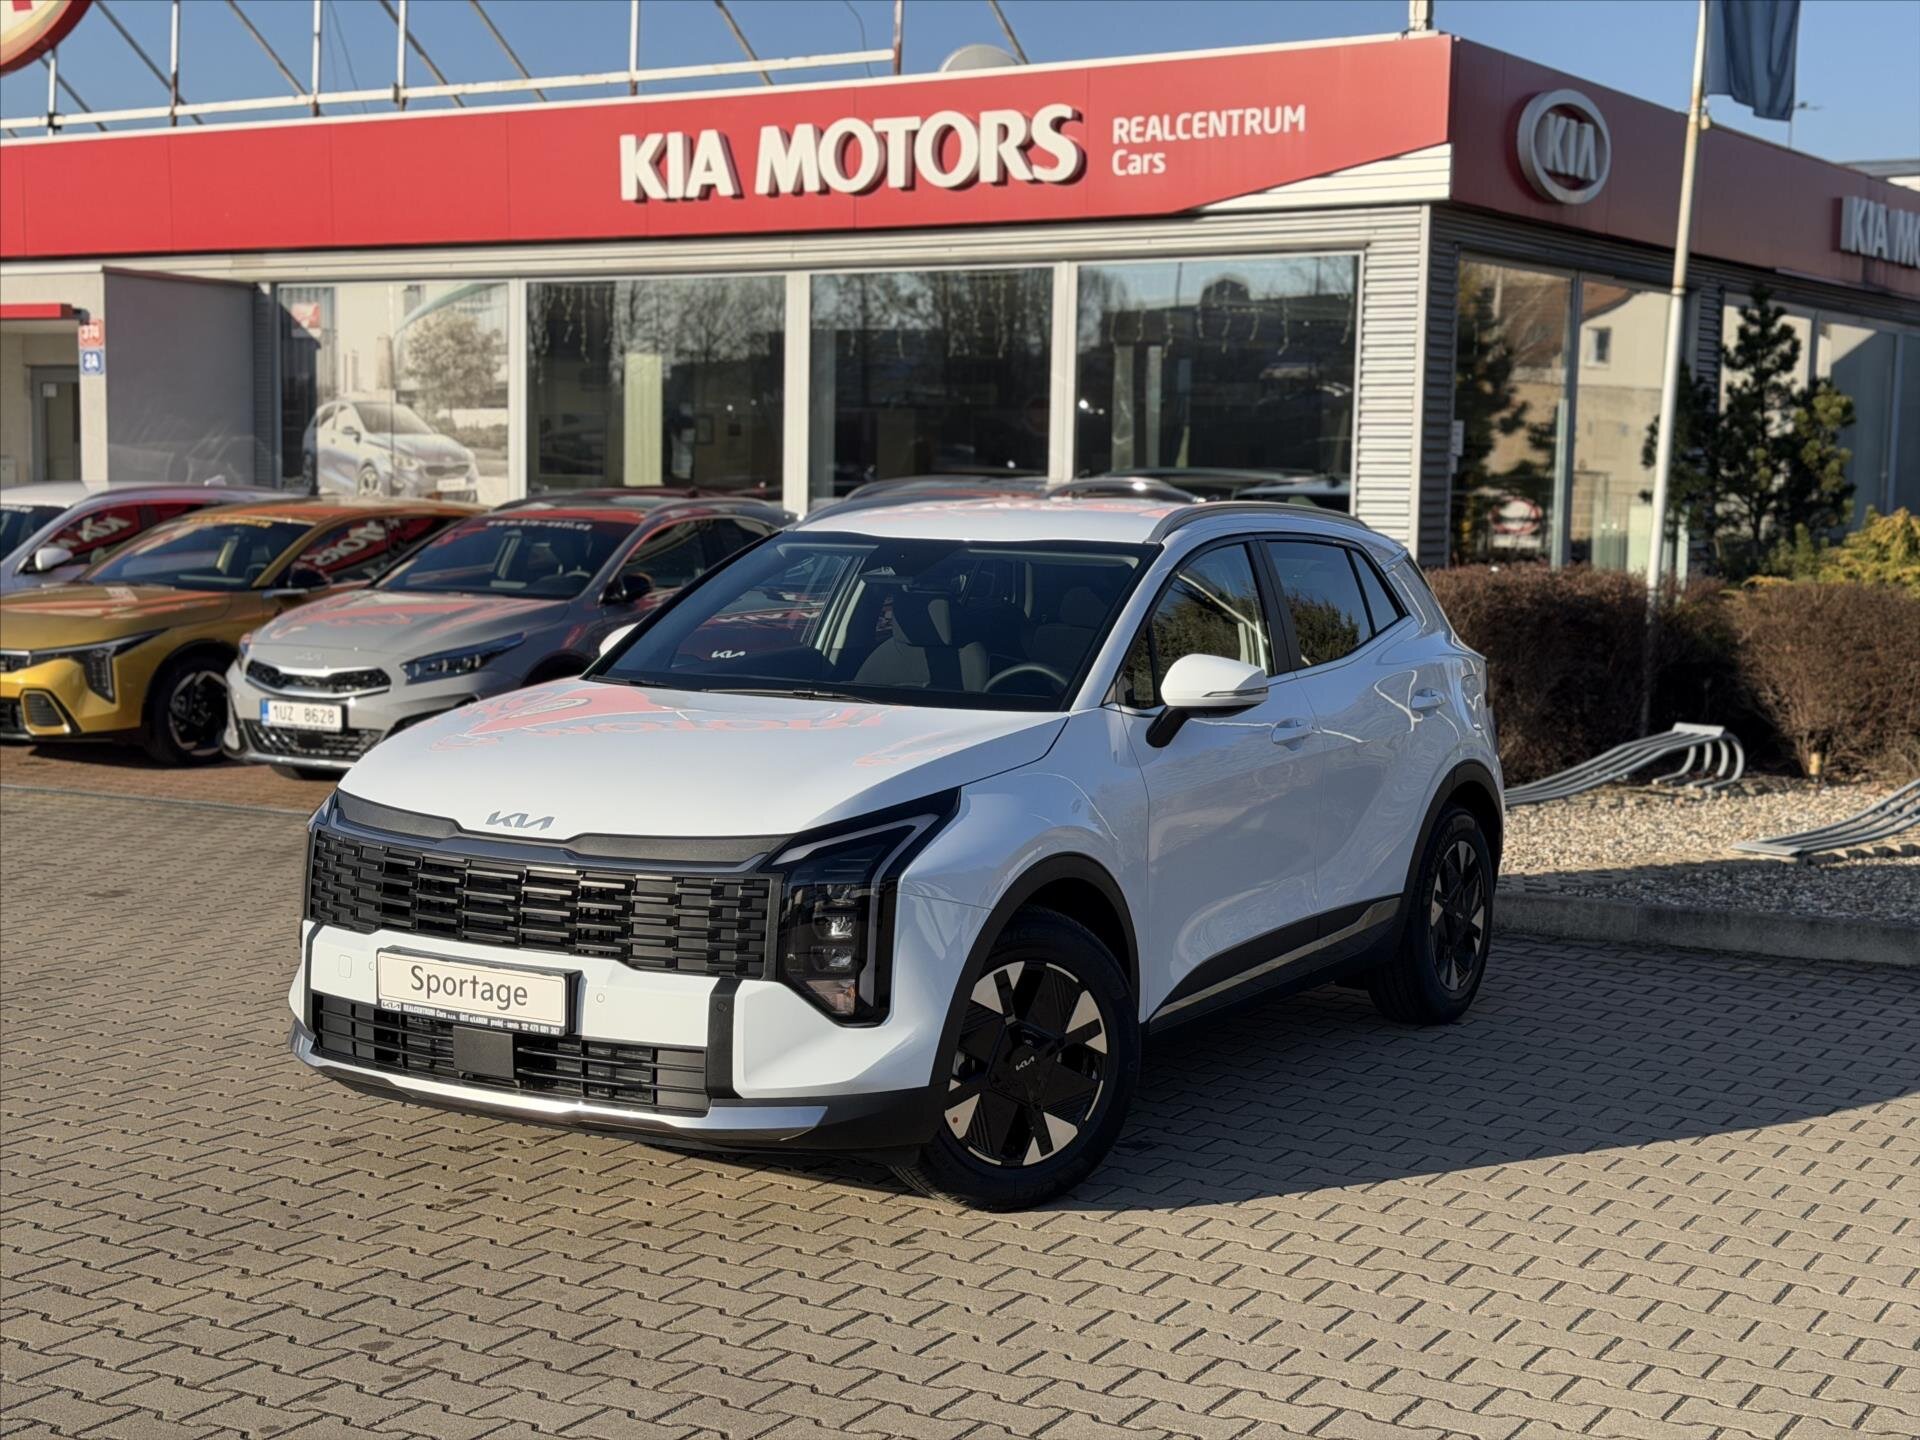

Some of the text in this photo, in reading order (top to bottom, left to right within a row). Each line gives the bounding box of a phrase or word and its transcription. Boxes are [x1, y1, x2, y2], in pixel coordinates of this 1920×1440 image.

[1112, 104, 1306, 145] REALCENTRUM
[1545, 111, 1598, 180] KIA
[619, 103, 1085, 202] KIA MOTORS
[1112, 149, 1166, 176] Cars
[1841, 195, 1889, 260] KIA
[304, 707, 335, 724] 8628
[485, 811, 555, 831] KIA
[411, 965, 528, 1011] Sportage
